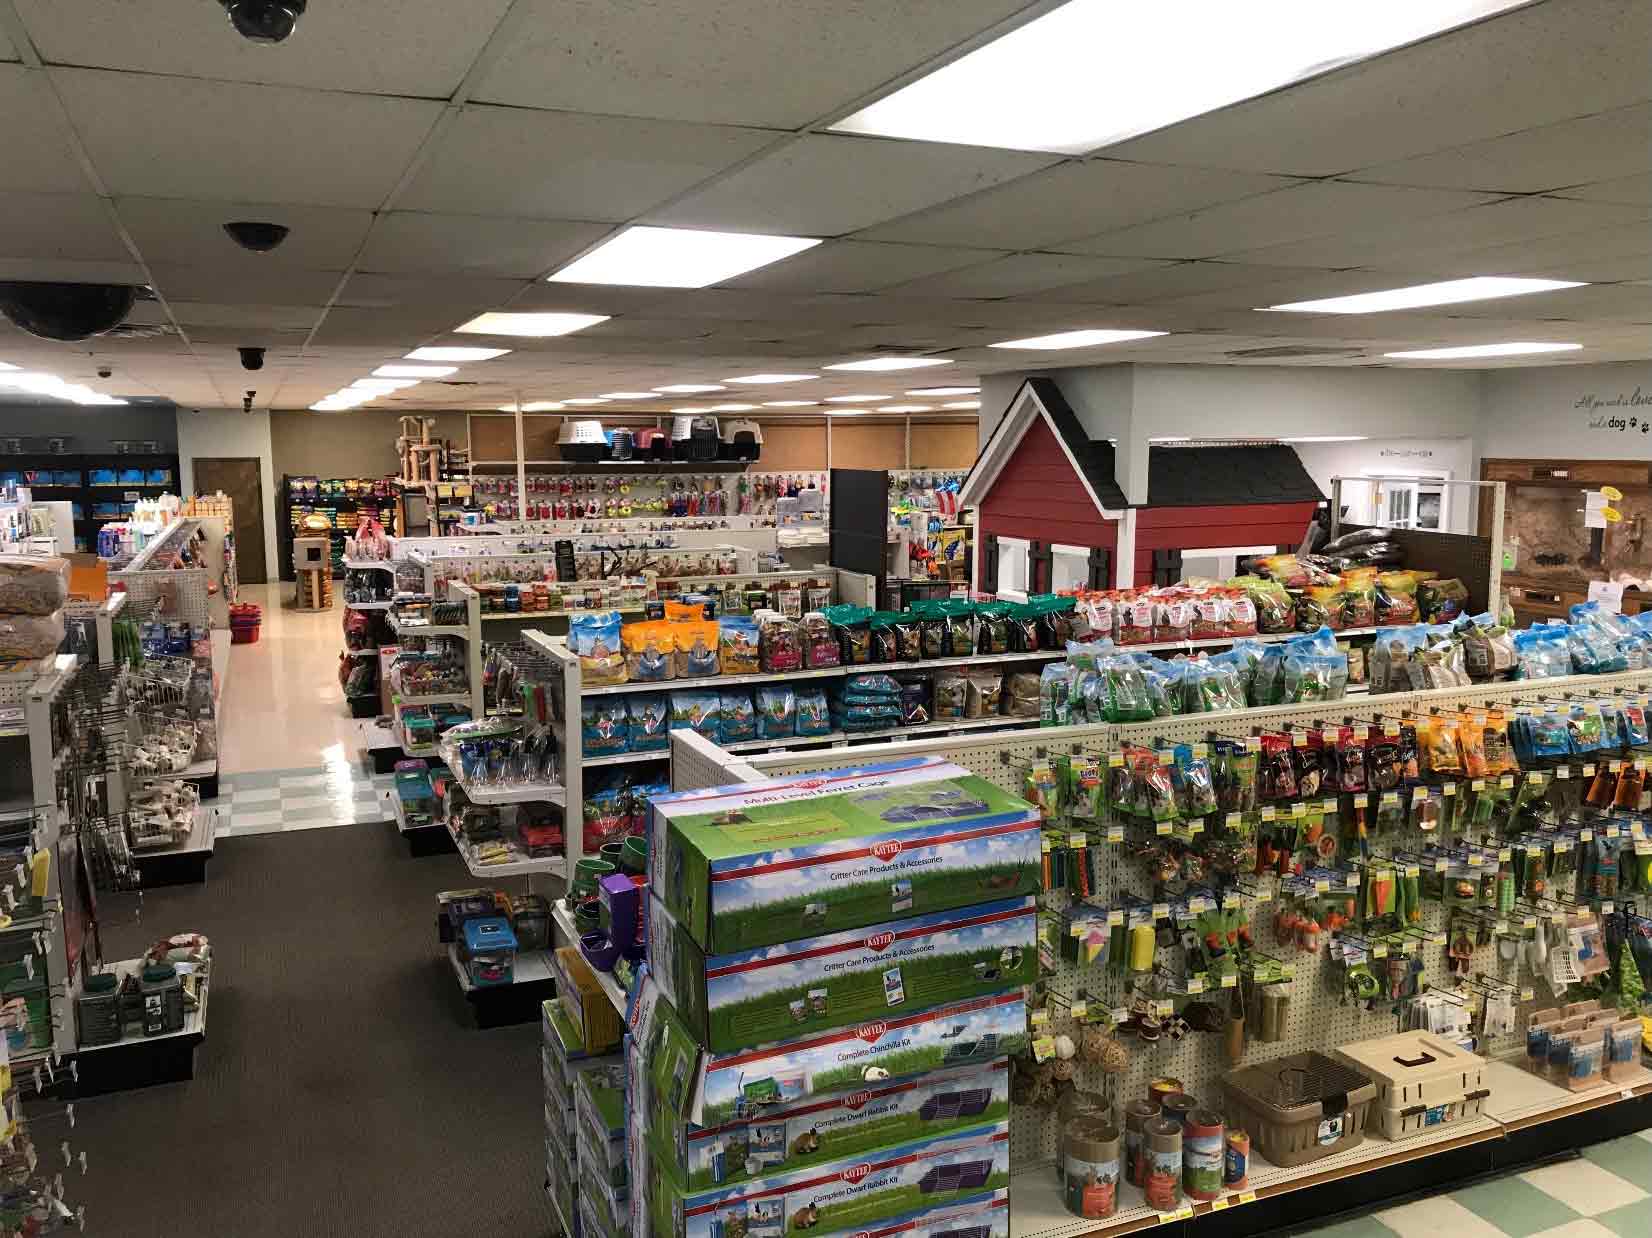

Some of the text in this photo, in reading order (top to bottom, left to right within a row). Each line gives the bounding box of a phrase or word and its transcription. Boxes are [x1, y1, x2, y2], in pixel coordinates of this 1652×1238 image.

[1608, 415, 1626, 431] dog
[817, 784, 857, 796] Ferret
[858, 779, 890, 788] Cage
[873, 842, 899, 856] KAYTEE
[830, 856, 944, 881] Critter Care Products & Accessories
[867, 933, 892, 947] KAYTEE
[824, 944, 935, 972] Critter Care Products & Accessories
[859, 1023, 884, 1037] KAYTEE
[838, 1038, 911, 1061] Complete Chinchilla Kit
[844, 1092, 870, 1105] KAYTEE
[814, 1115, 846, 1129] Complete
[847, 1110, 867, 1121] Dwarf
[889, 1103, 898, 1112] Kit
[844, 1165, 868, 1180] KAYTEE
[813, 1175, 898, 1203] Complete Dwarf Rabbit Kit
